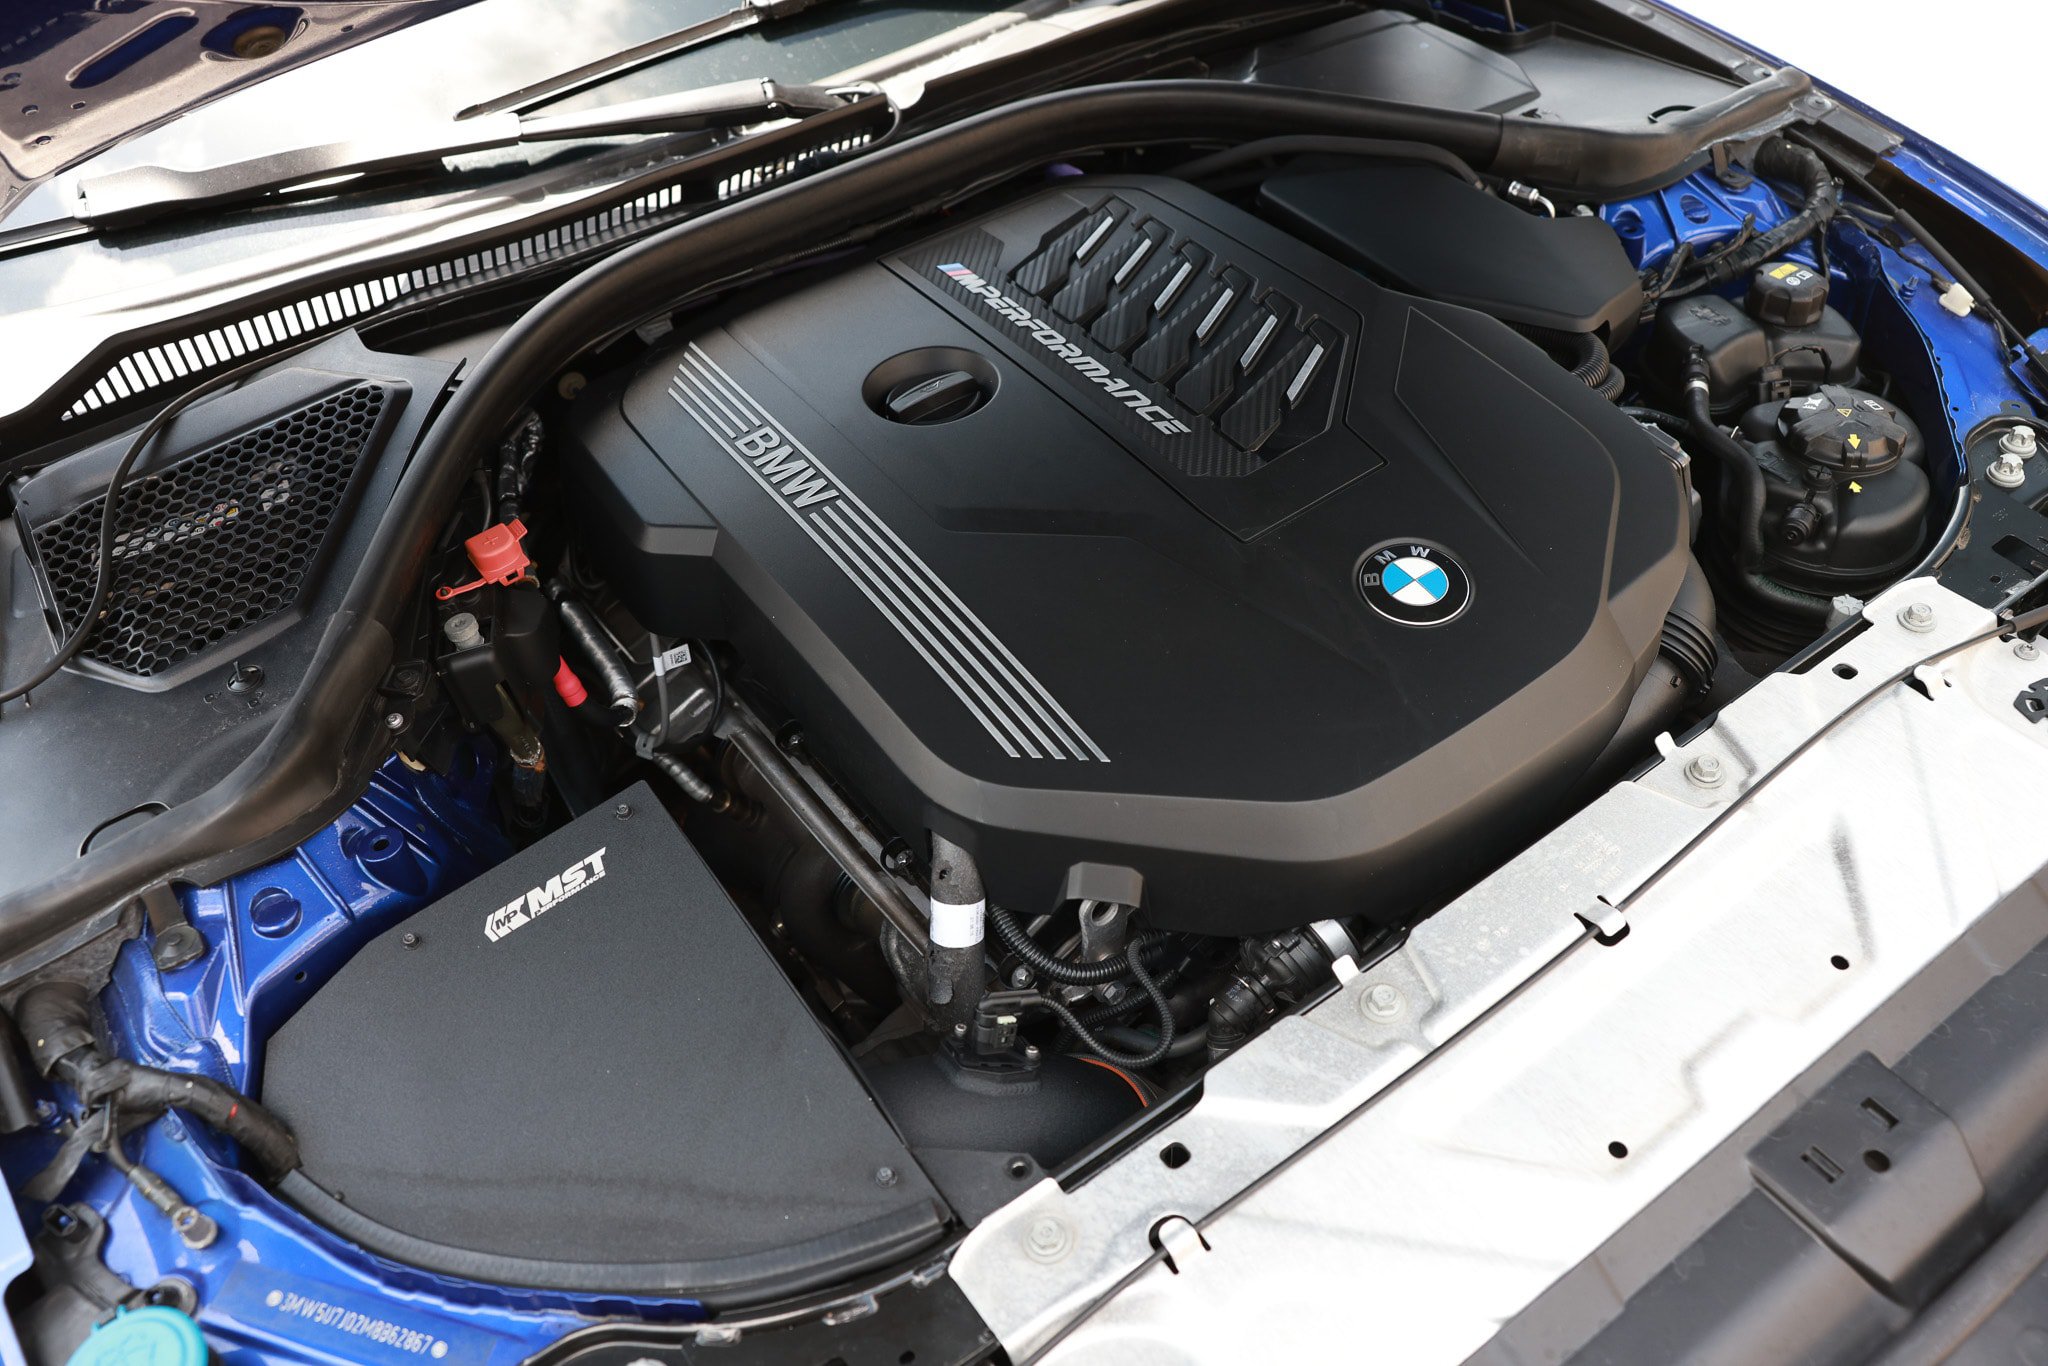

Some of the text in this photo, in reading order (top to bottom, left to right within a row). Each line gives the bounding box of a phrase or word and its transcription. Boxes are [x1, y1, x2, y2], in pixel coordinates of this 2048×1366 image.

[734, 425, 840, 509] BMW
[1364, 545, 1431, 587] BMW
[526, 846, 607, 920] MST
